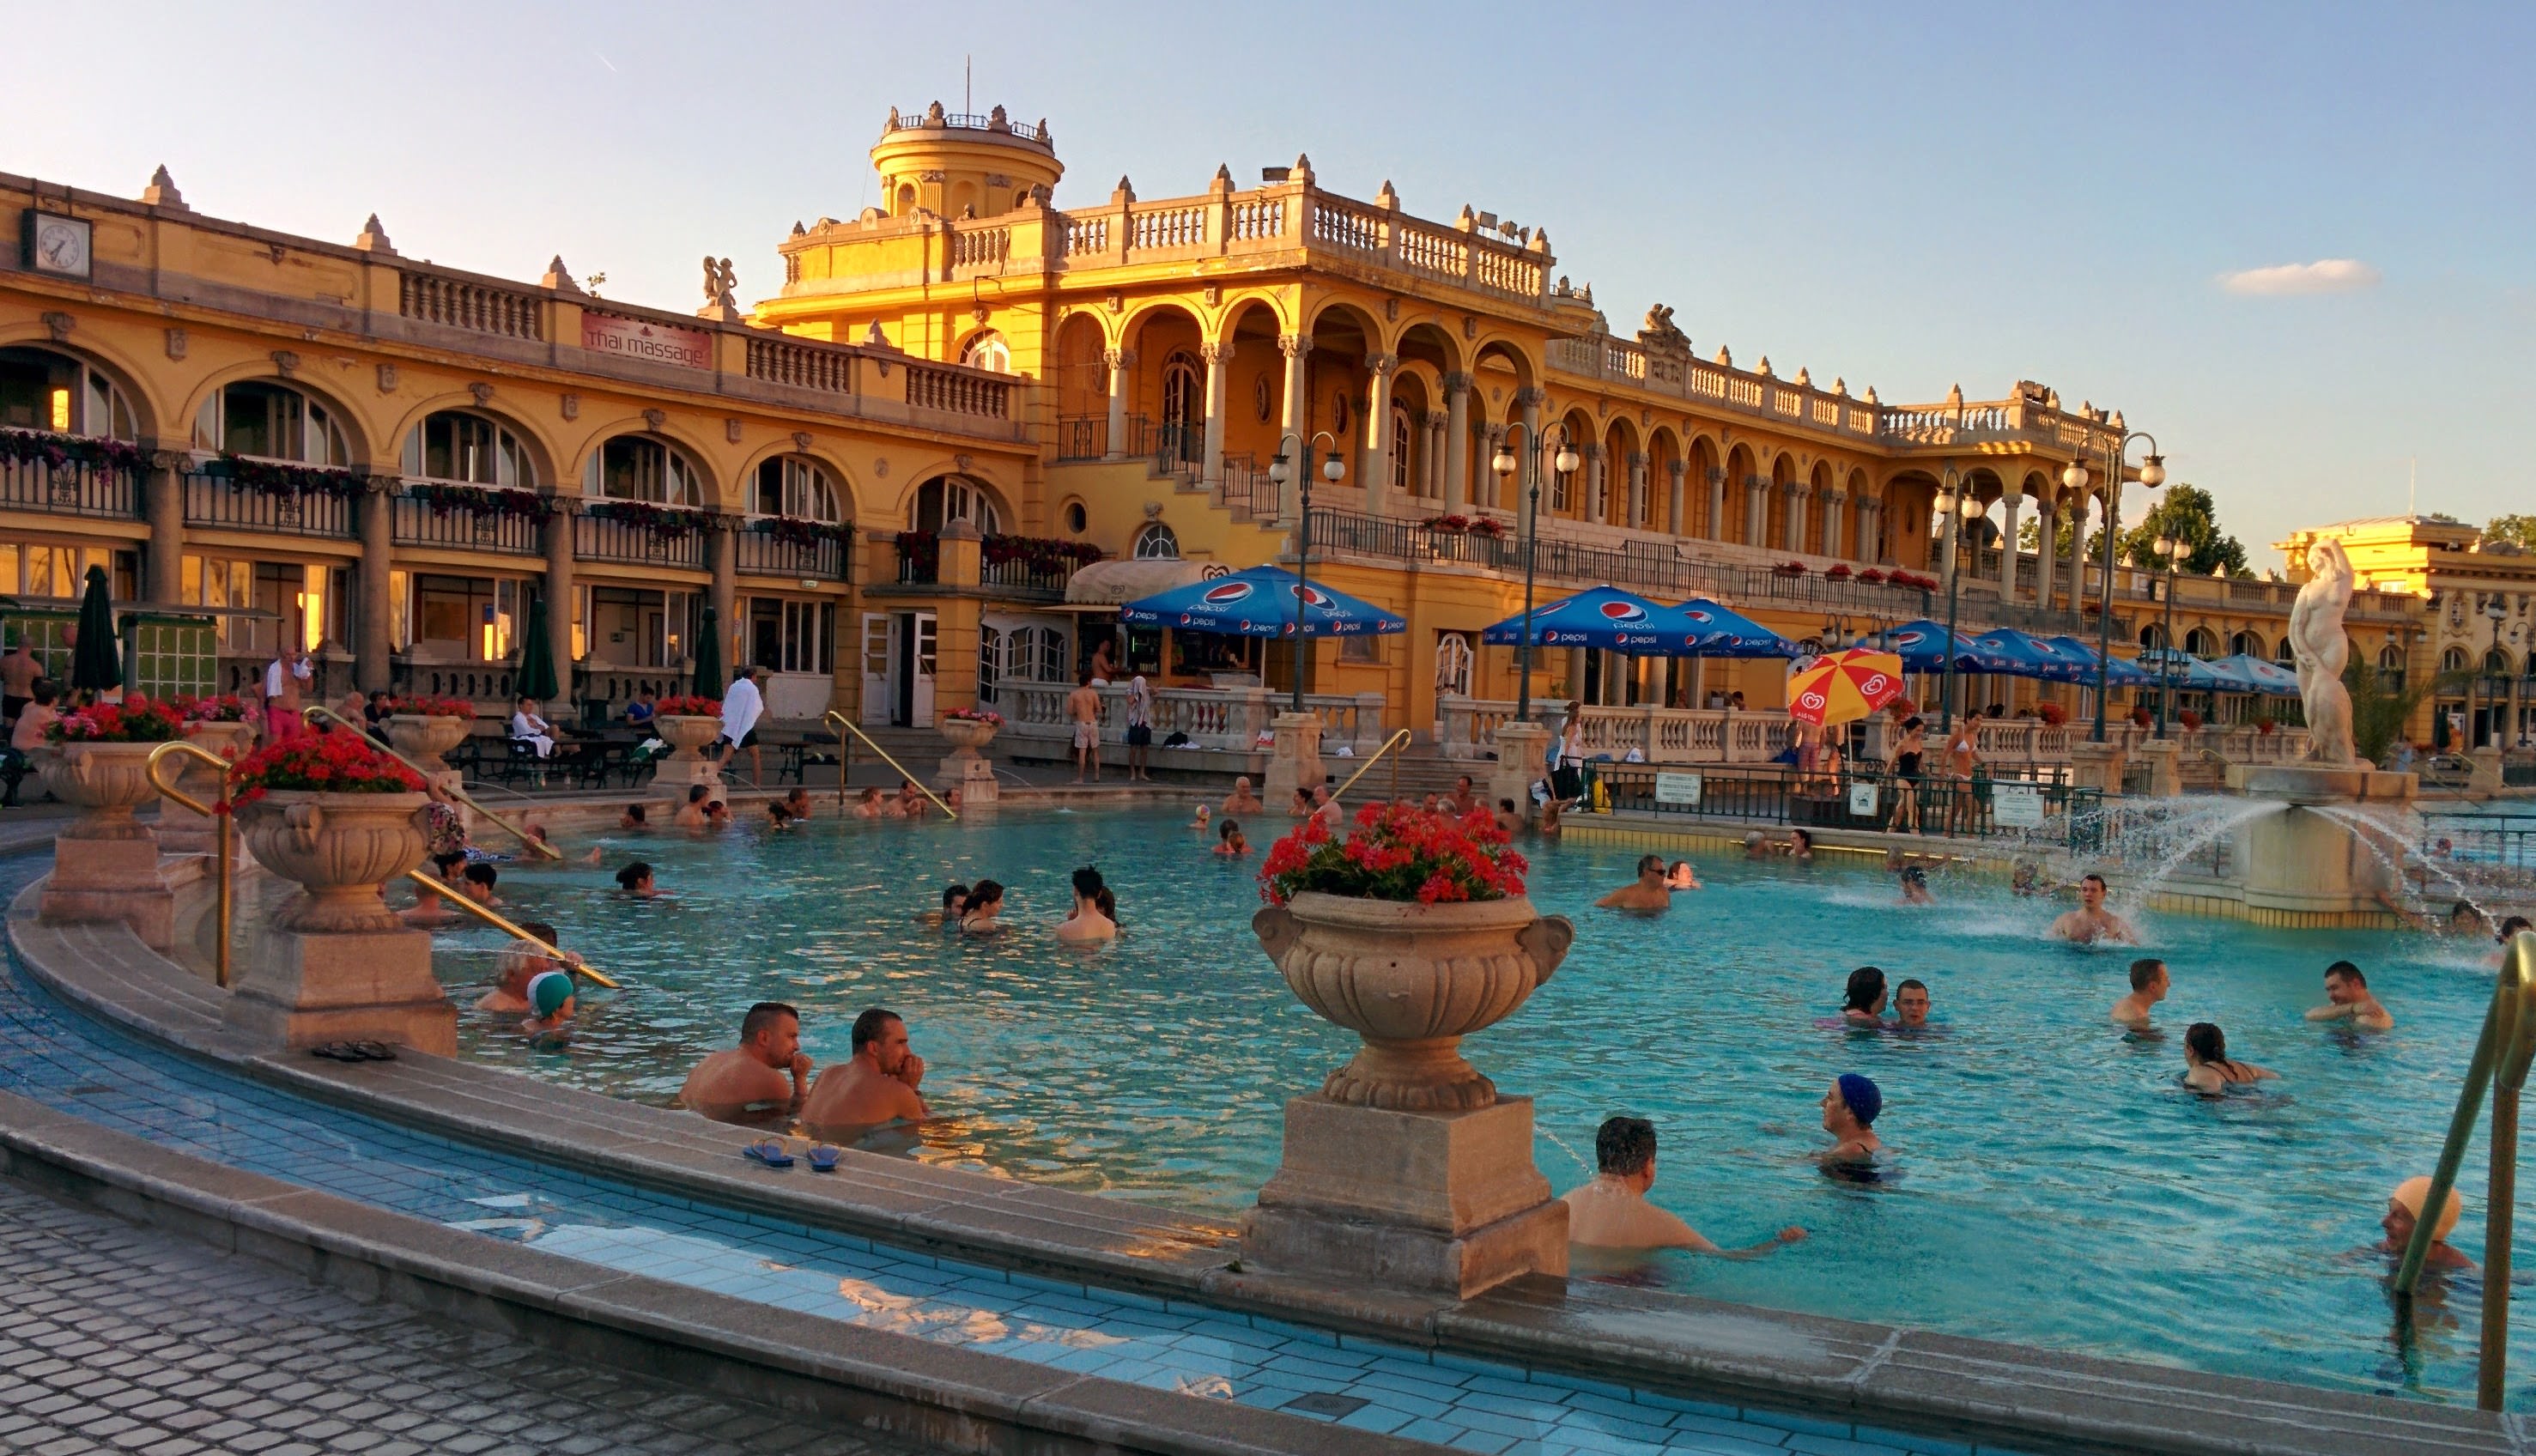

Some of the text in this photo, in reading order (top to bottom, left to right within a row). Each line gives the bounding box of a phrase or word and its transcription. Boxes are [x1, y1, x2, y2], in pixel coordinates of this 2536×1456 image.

[587, 329, 703, 365] Thai massage
[1135, 611, 1157, 622] pepsi
[1192, 617, 1216, 627] pepsi
[1343, 622, 1361, 632] pepsi
[1252, 623, 1277, 633] pepsi
[1561, 633, 1587, 642] pepsi
[1630, 634, 1657, 645] pepsi
[1744, 639, 1771, 647] pepsi
